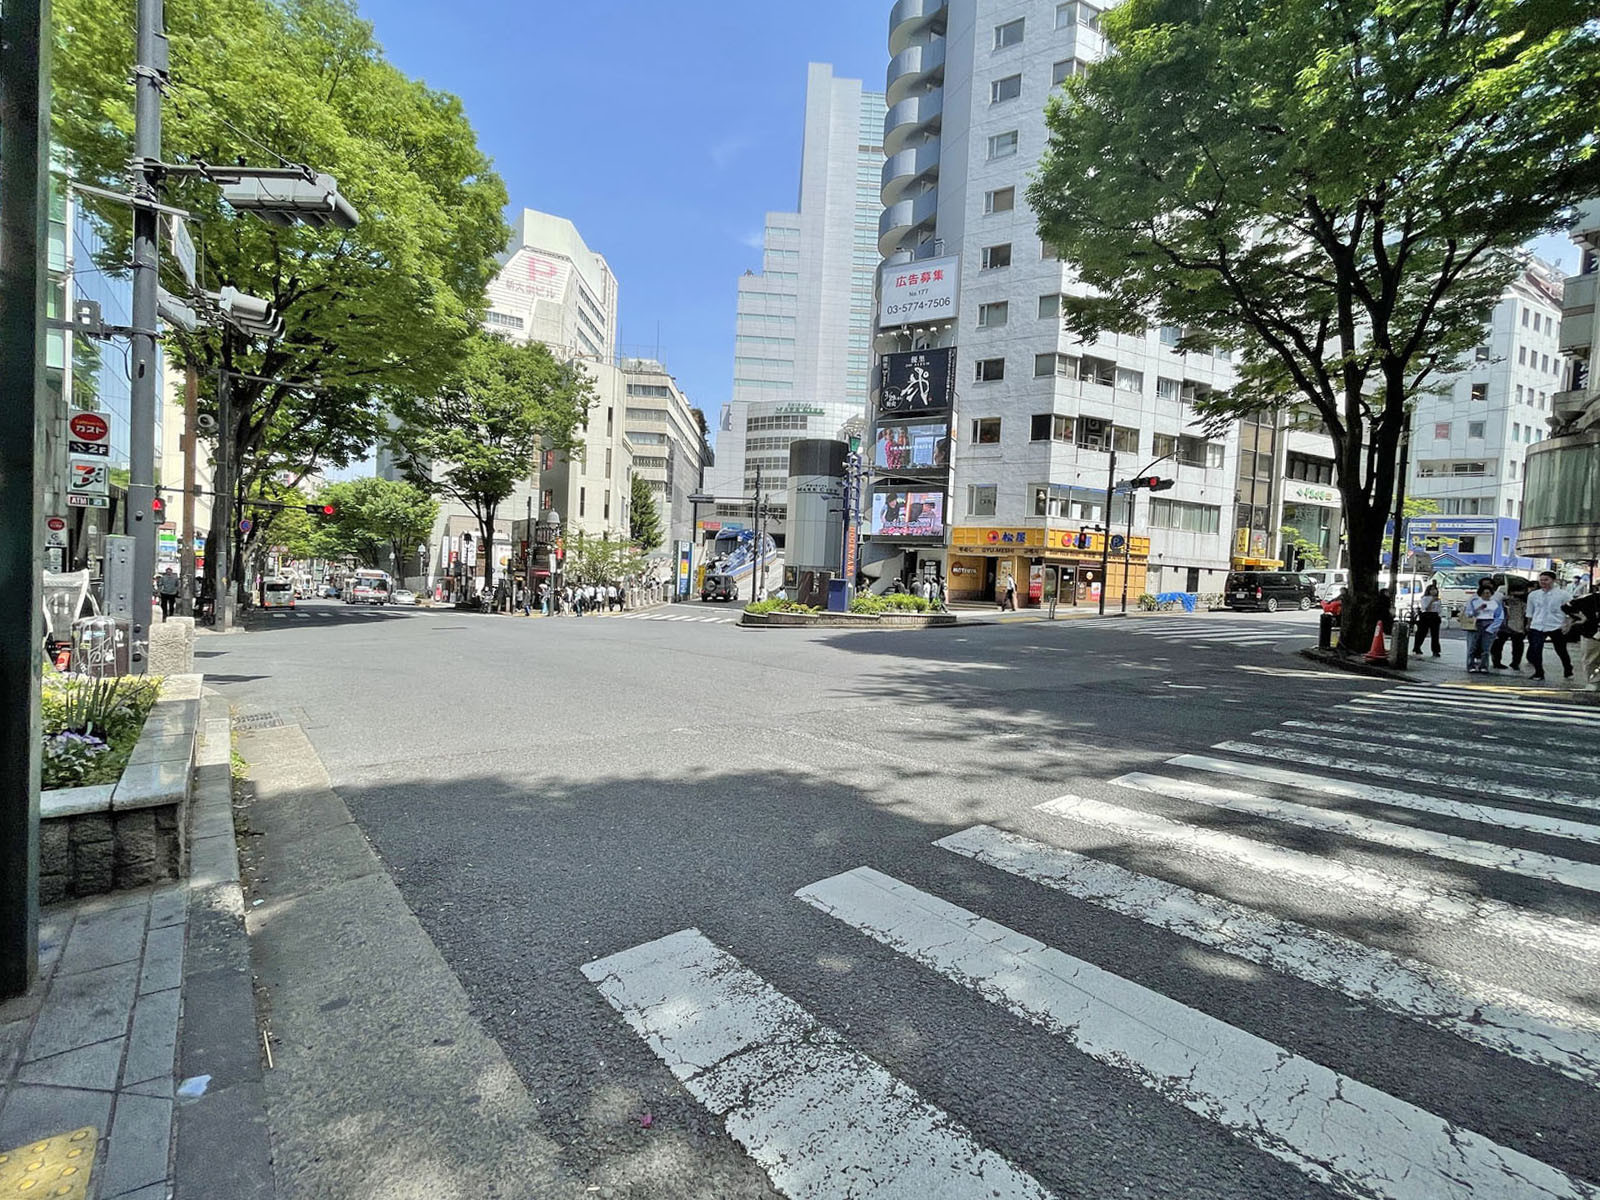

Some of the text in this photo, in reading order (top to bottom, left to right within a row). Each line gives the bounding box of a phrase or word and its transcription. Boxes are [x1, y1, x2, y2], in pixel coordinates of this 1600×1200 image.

[527, 255, 559, 281] P
[895, 269, 944, 288] 広告募集
[886, 296, 951, 315] 03-5774-7506
[75, 424, 105, 434] ガスト
[89, 444, 109, 455] 2F
[71, 496, 87, 505] ATM
